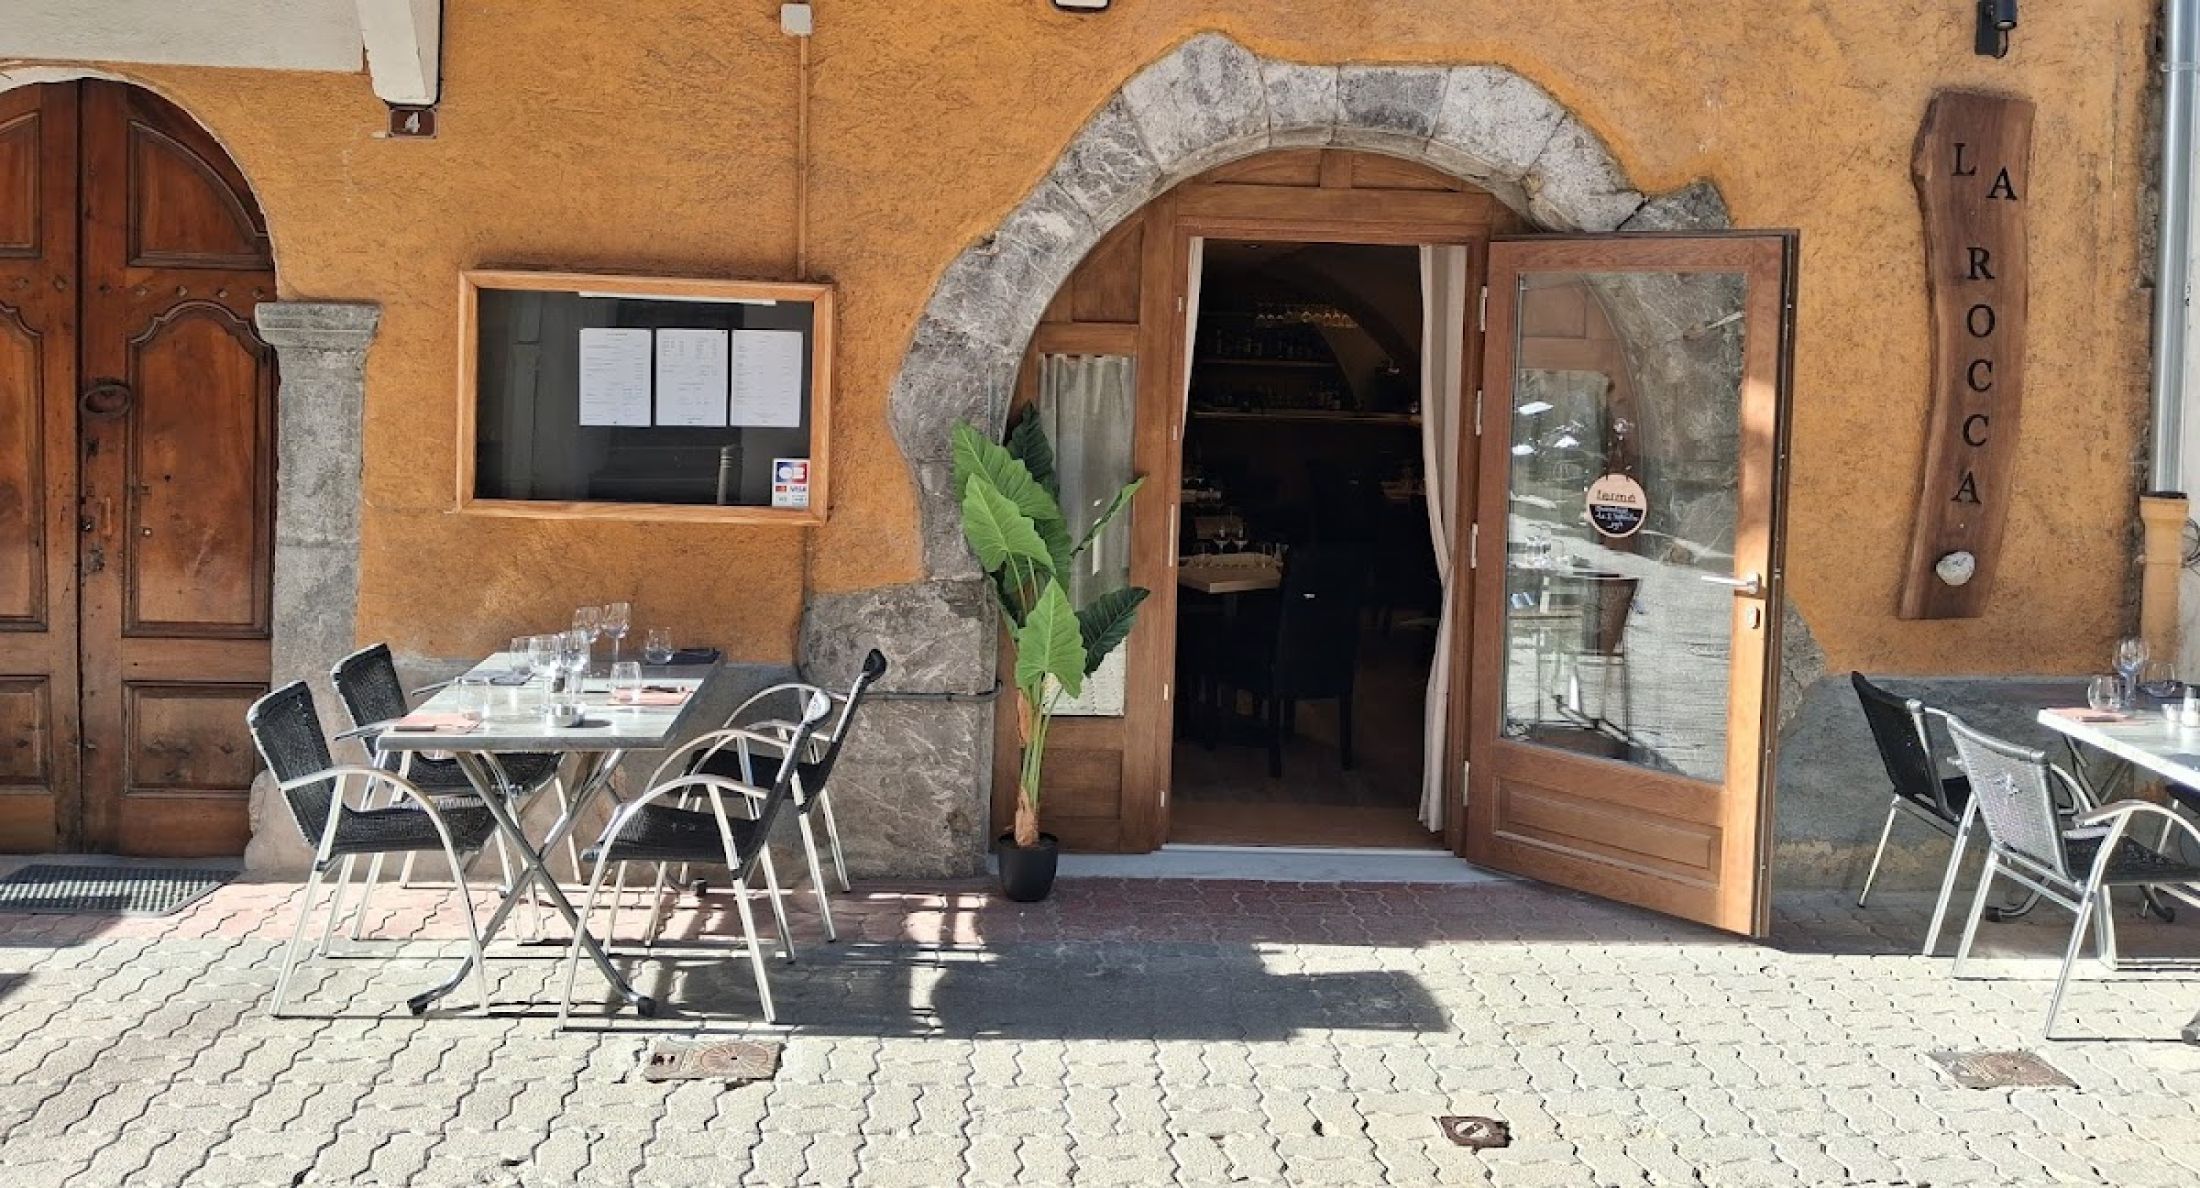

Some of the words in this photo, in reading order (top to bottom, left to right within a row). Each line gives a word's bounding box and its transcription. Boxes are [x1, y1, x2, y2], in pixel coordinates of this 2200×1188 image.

[404, 111, 420, 134] 4
[1951, 142, 2017, 200] LA
[1950, 247, 1996, 505] ROCCA
